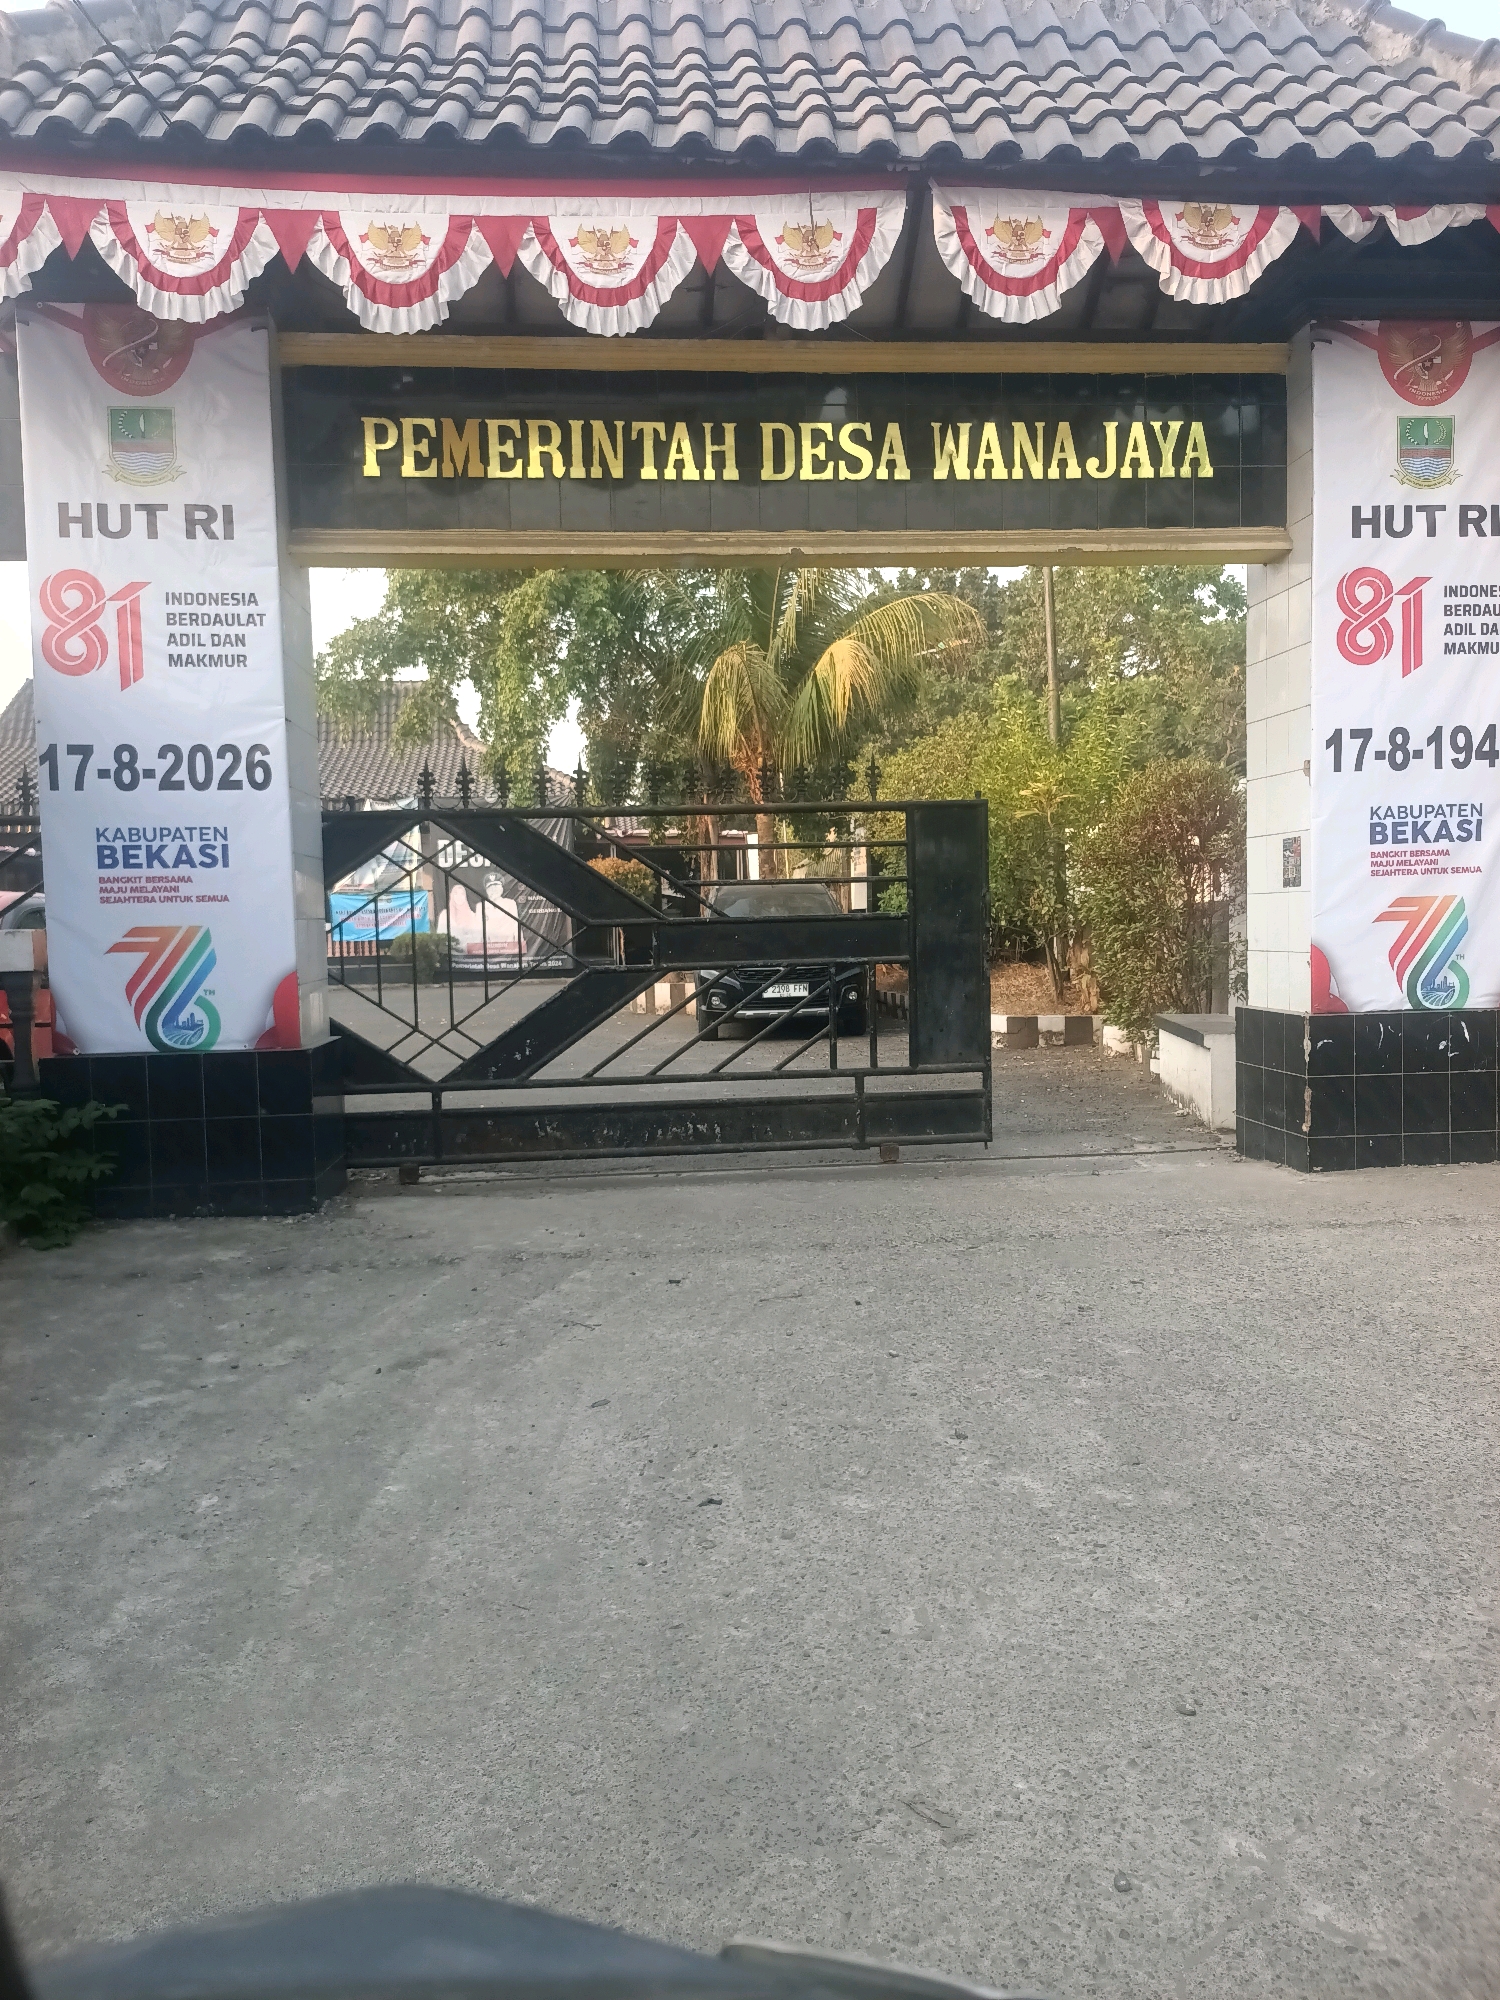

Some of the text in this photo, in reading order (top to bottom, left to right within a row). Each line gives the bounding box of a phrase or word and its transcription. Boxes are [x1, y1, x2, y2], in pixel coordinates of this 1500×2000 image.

[361, 416, 1215, 481] PEMERINTAH DESA WANAJAYA
[57, 502, 236, 541] HUT RI
[1350, 504, 1500, 539] HUT RI
[1443, 584, 1500, 598] INDONE
[165, 591, 259, 607] INDONESIA
[1443, 603, 1500, 617] BERDAU
[166, 612, 267, 627] BERDAULAT
[1336, 566, 1434, 678] 81
[39, 567, 152, 692] 81
[1443, 622, 1477, 636] ADIL
[166, 633, 246, 648] ADIL DAN
[1443, 641, 1500, 655] MAKMU
[168, 653, 248, 668] MAKMUR
[1325, 723, 1500, 773] 17-8-194
[39, 743, 273, 792] 17-8-2026
[1369, 803, 1483, 820] KABUPATEN
[95, 826, 229, 843] KABUPATEN
[1369, 819, 1483, 846] BEKASI
[97, 844, 230, 870] BEKASI
[437, 839, 492, 868] DES
[1370, 849, 1451, 859] BANGKIT BERSAMA
[1370, 858, 1439, 868] MAJU MELAYANI
[1370, 866, 1482, 877] SEJAHTERA UNTUK SEMUA
[98, 875, 193, 884] BANGKIT BERSAMA
[99, 885, 180, 894] MAJU MELAYANI
[99, 894, 230, 904] SEJAHTERA UNTUK SEMUA
[793, 984, 808, 993] FFN
